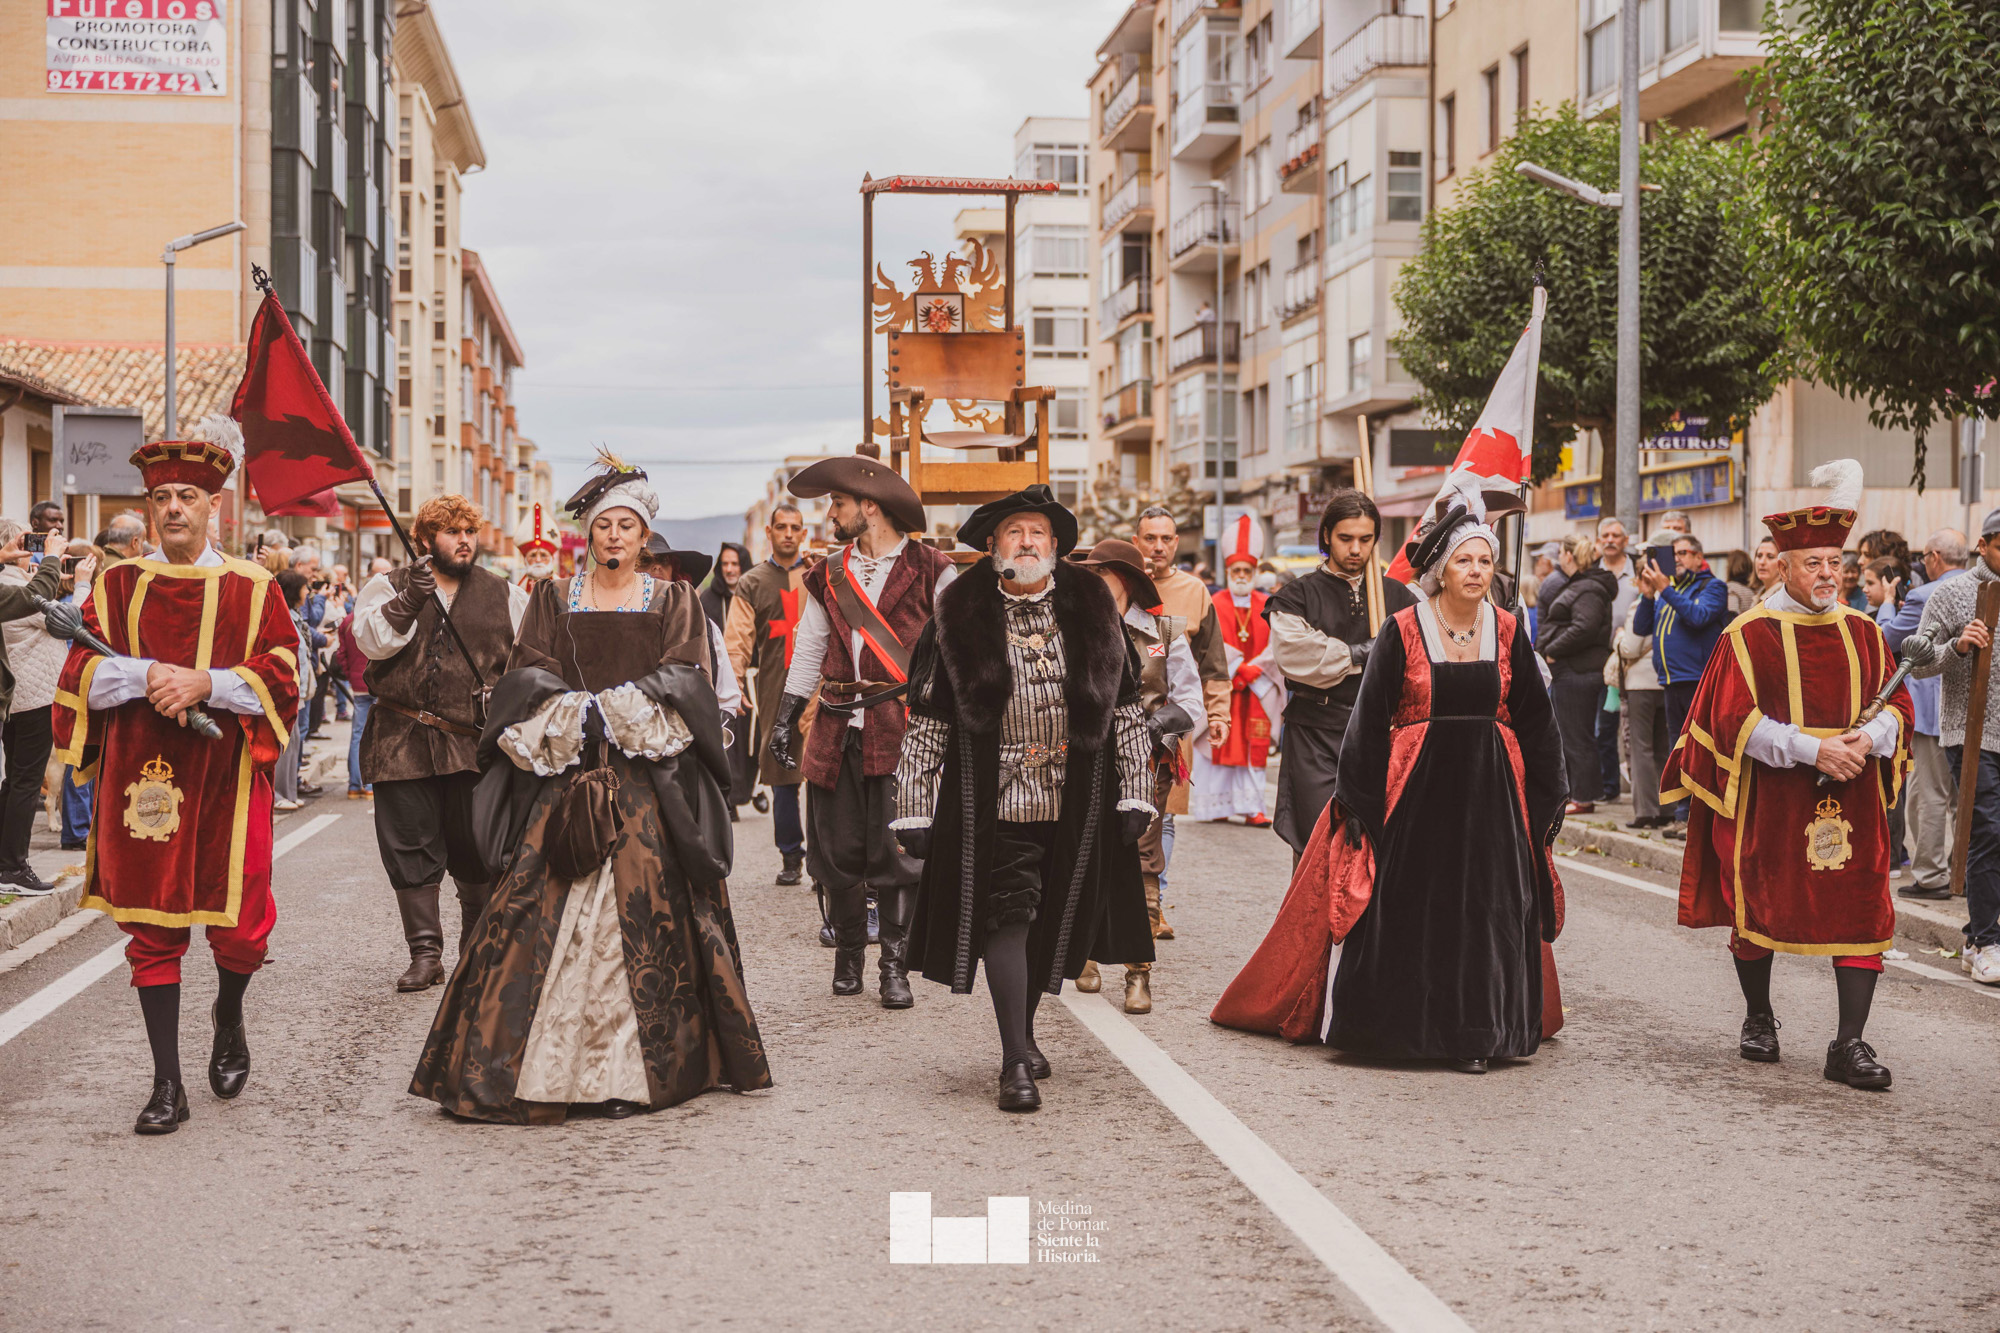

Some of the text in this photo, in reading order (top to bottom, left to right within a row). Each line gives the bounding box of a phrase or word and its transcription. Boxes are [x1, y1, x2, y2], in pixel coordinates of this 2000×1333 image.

[53, 0, 213, 20] Furelos
[75, 21, 197, 35] PROMOTORA
[57, 36, 212, 53] CONSTRUCTORA
[53, 54, 90, 64] AVDA
[95, 54, 143, 65] BILBAO
[185, 57, 220, 66] BAJO
[48, 70, 196, 92] 947 14 72 42
[1638, 436, 1730, 450] EGUROS
